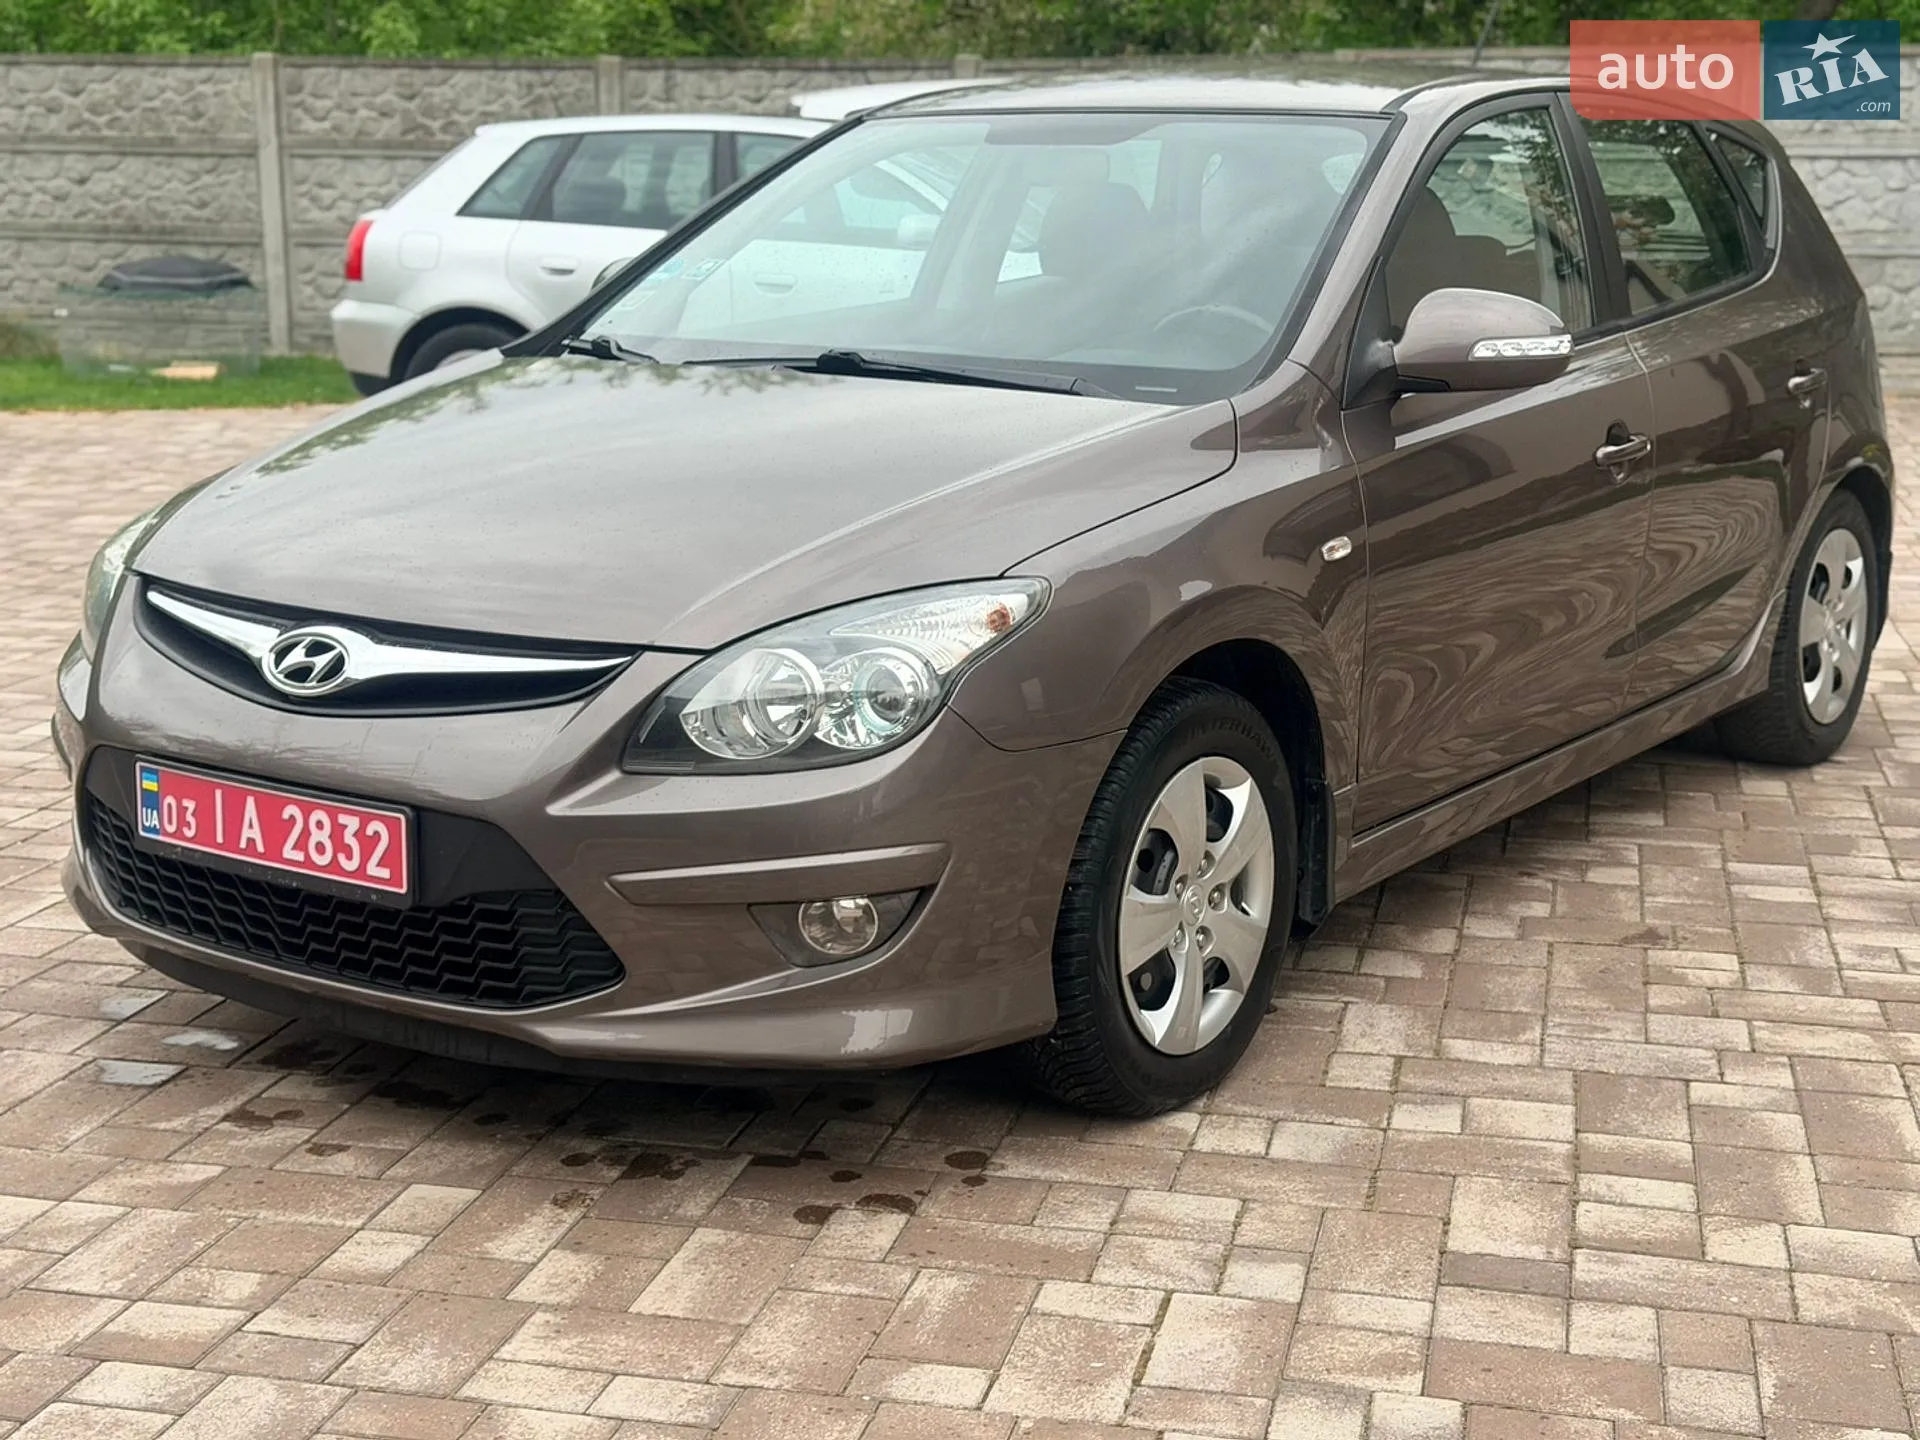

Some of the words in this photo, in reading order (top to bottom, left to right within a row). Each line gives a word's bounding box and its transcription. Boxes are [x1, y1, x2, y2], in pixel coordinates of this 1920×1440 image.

[142, 807, 160, 830] UA
[162, 795, 197, 838] 03
[214, 788, 266, 854] IA
[281, 804, 391, 880] 2832
